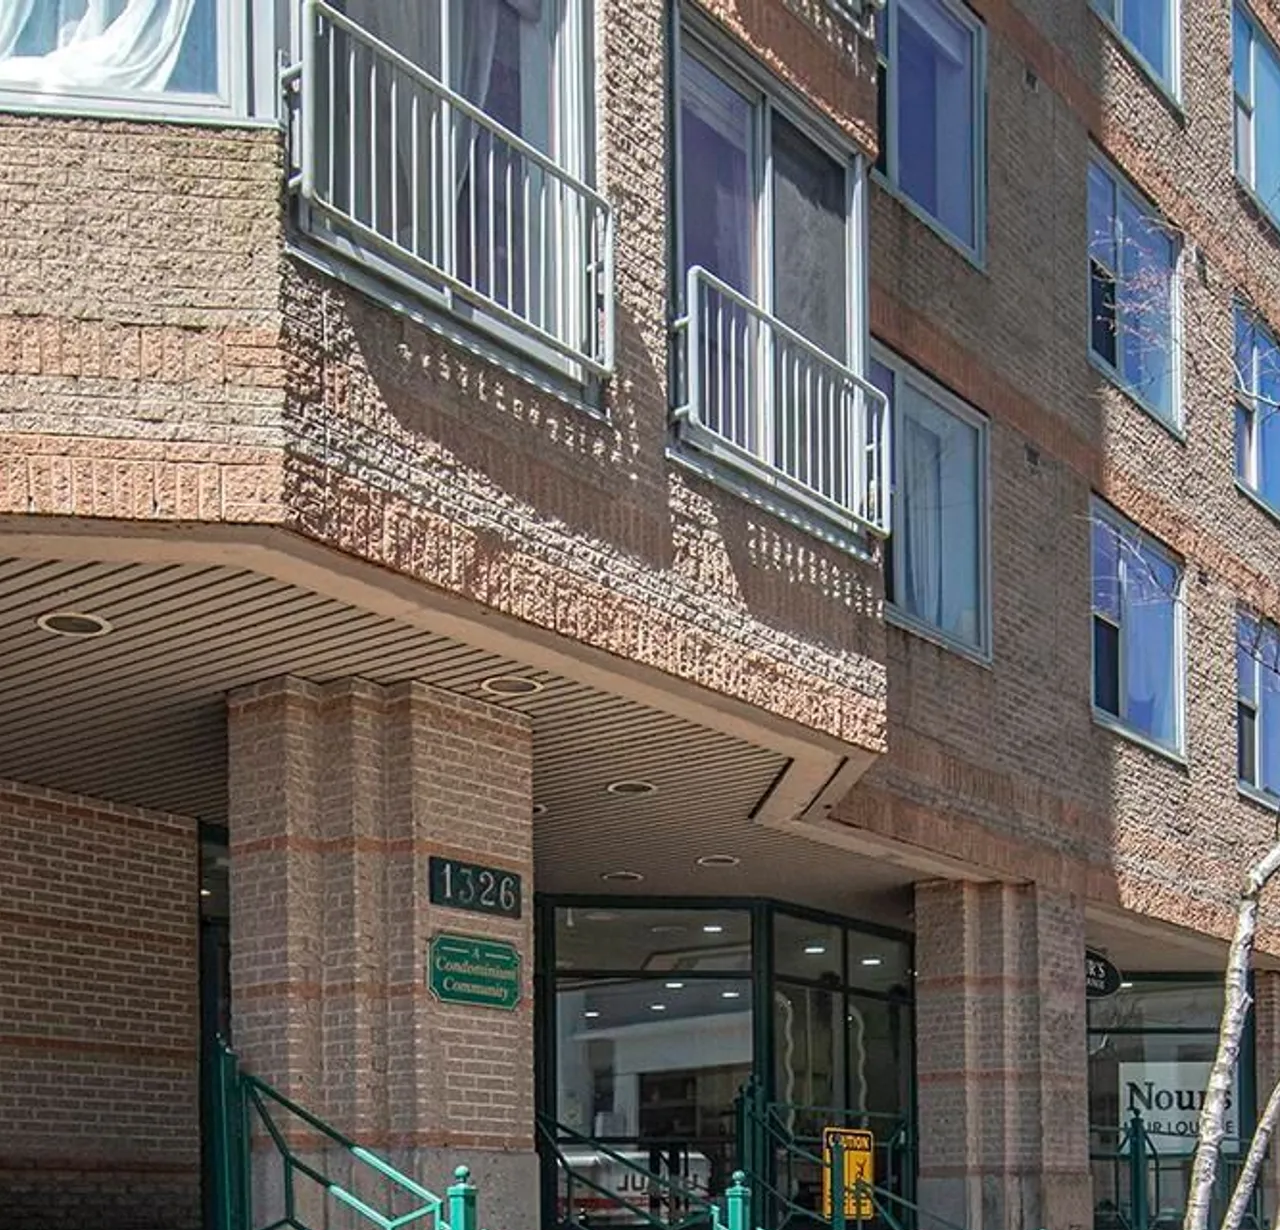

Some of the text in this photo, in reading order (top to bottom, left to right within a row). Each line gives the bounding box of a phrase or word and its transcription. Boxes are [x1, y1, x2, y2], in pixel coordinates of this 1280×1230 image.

[443, 863, 515, 911] 1326
[436, 956, 516, 980] Condominium
[442, 976, 509, 1001] Community
[830, 1134, 869, 1149] CUTION
